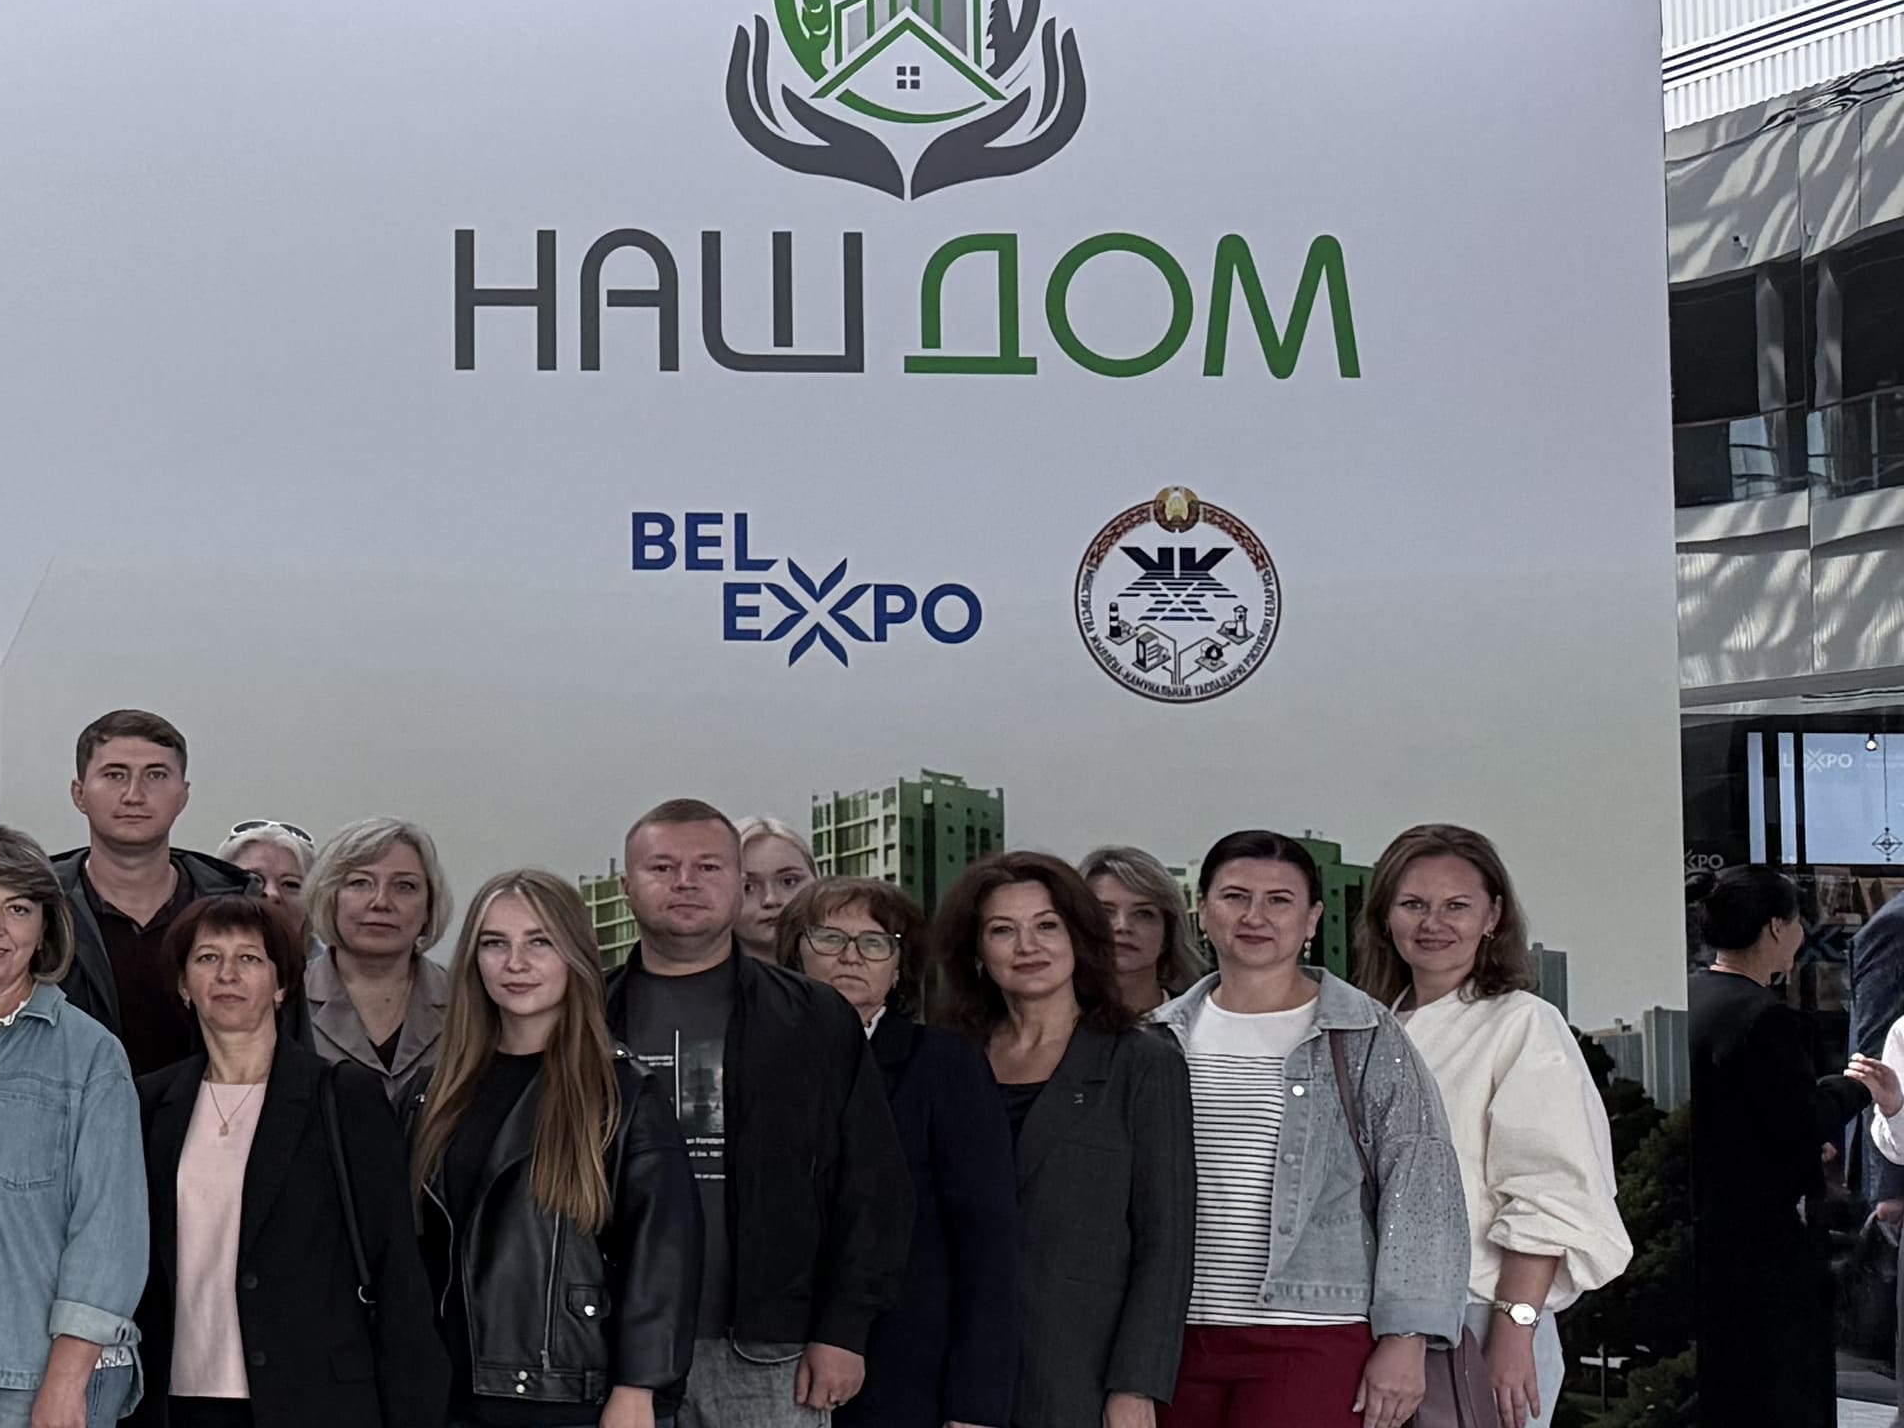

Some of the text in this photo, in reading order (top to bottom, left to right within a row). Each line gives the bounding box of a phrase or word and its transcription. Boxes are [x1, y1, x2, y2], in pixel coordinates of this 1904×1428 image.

[455, 229, 1360, 379] НАШ ДОМ
[632, 512, 778, 571] BEL
[723, 557, 982, 668] EXPO
